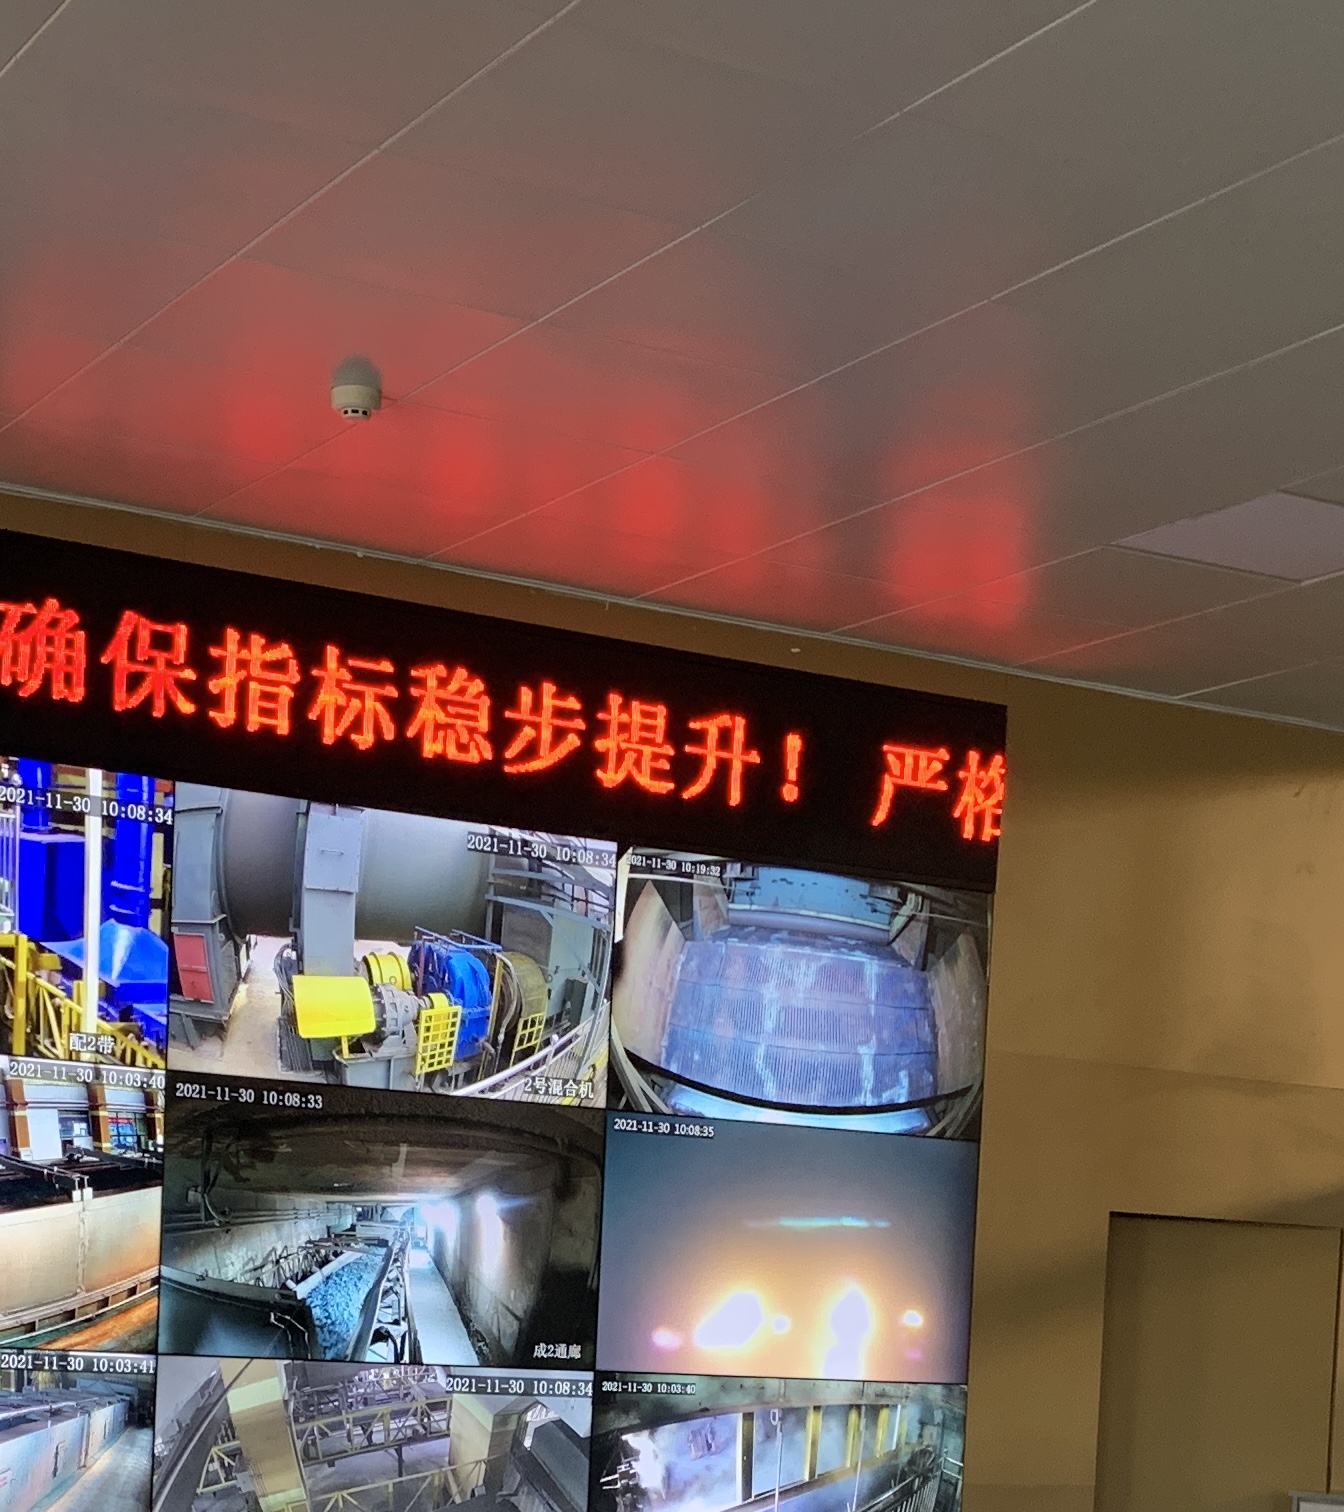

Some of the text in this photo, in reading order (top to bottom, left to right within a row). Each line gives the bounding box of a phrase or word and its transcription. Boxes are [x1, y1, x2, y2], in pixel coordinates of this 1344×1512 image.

[100, 799, 173, 826] 10:08:34
[467, 832, 617, 867] 2021-11-30 10:08:34
[69, 1032, 115, 1055] 配2带
[9, 1060, 165, 1090] 2021-11-30 10:03:40
[175, 1083, 323, 1109] 2021-11-30 10:08:33
[524, 1077, 594, 1099] 2号混合机
[614, 1118, 714, 1138] 2021-11-30 10:08:35
[0, 1354, 155, 1375] 2021-11-30 10:03:41
[446, 1377, 593, 1397] 2021-11-30 10:08:34
[602, 1381, 697, 1396] 2021-11-30 10:03:40
